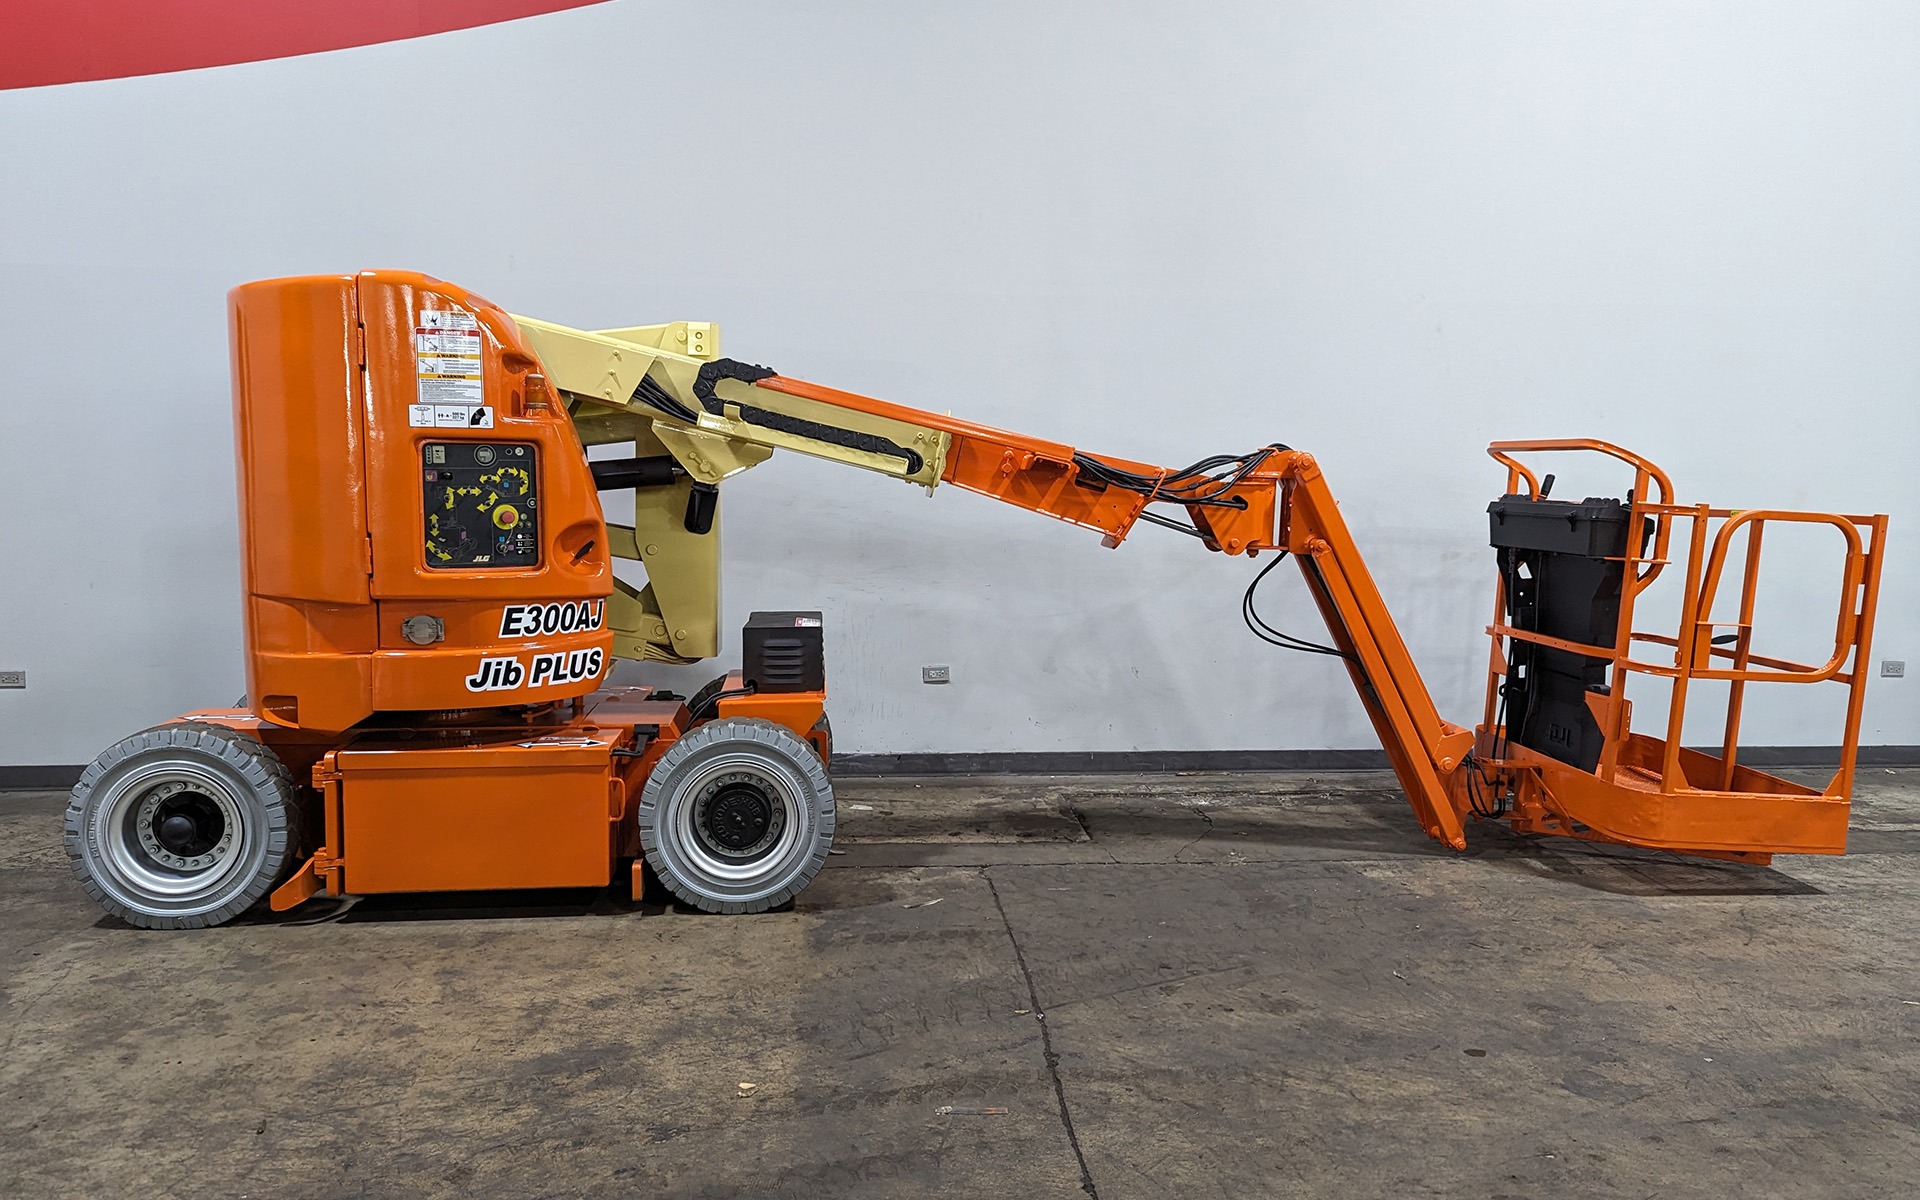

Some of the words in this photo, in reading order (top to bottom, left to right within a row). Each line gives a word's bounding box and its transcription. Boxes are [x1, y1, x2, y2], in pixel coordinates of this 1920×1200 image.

[472, 555, 491, 563] JLG
[501, 600, 604, 637] E300AJ
[468, 659, 523, 690] Jib
[531, 649, 603, 685] PLUS
